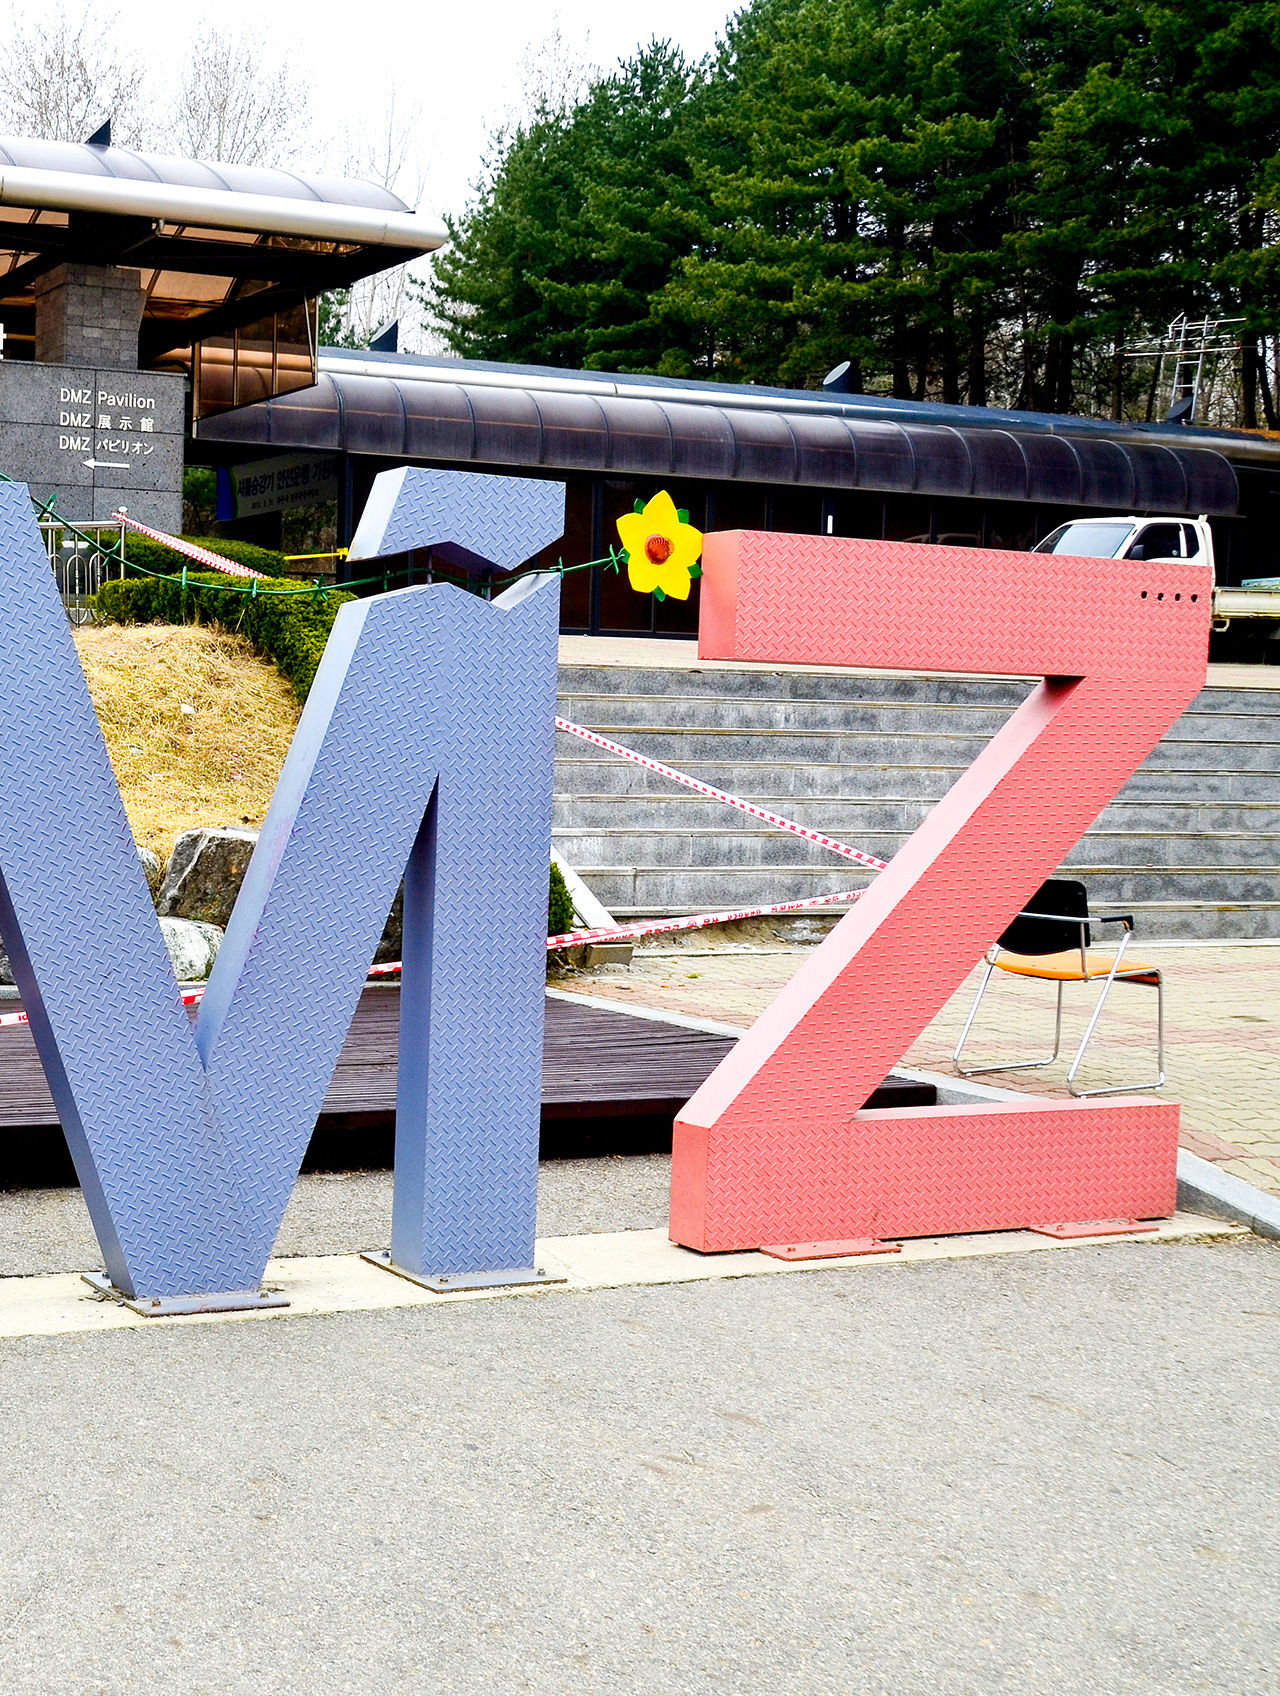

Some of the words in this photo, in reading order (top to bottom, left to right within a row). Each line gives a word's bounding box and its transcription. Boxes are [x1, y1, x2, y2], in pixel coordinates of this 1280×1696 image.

[60, 388, 92, 405] DMZ
[97, 391, 156, 410] Pavilion
[59, 412, 91, 428] DMZ
[59, 435, 91, 452] DMZ
[96, 438, 155, 456] パビリオン
